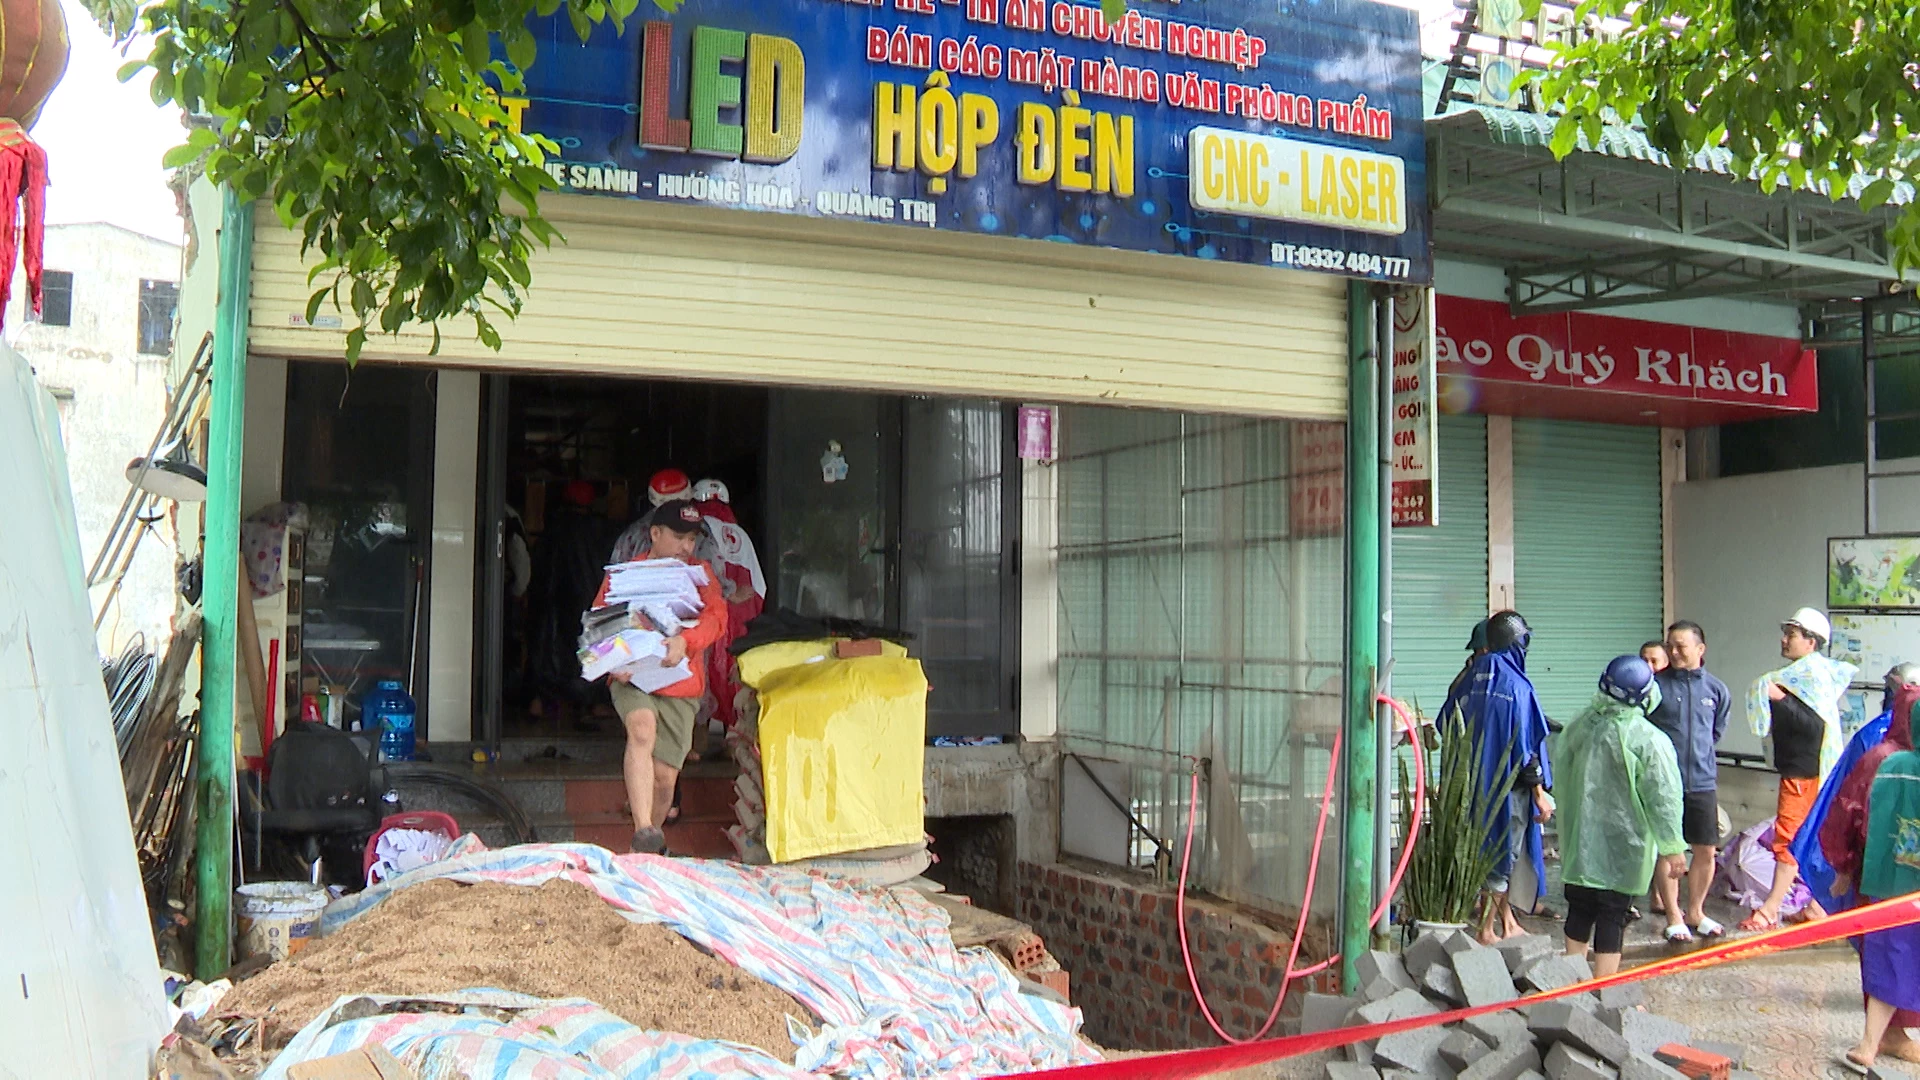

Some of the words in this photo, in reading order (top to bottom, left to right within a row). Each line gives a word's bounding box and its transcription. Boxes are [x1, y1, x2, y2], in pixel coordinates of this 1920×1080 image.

[1052, 2, 1162, 51] CHUYÊN
[1167, 22, 1267, 72] NGHIỆP
[640, 20, 807, 164] LED
[873, 69, 999, 195] HỘP
[1014, 88, 1135, 198] ĐÈN
[867, 25, 932, 69] BÁN
[938, 35, 1002, 79] CÁC
[1008, 46, 1075, 93] MẶT
[1081, 57, 1160, 102] HÀNG
[1165, 71, 1221, 113] VĂN
[1225, 83, 1314, 128] PHÒNG
[1317, 93, 1393, 141] PHẨM
[569, 164, 638, 194] SANH
[816, 187, 895, 220] QUẢNG
[899, 198, 938, 229] TRỊ
[1202, 133, 1270, 207] CNC
[1300, 149, 1399, 225] LASER
[1346, 252, 1382, 276] 484
[1383, 257, 1411, 279] 777
[1436, 326, 1493, 366] ào
[1506, 334, 1616, 384] Quý
[1634, 345, 1788, 397] Khách
[1393, 429, 1416, 446] EM
[1392, 495, 1424, 508] 4.367
